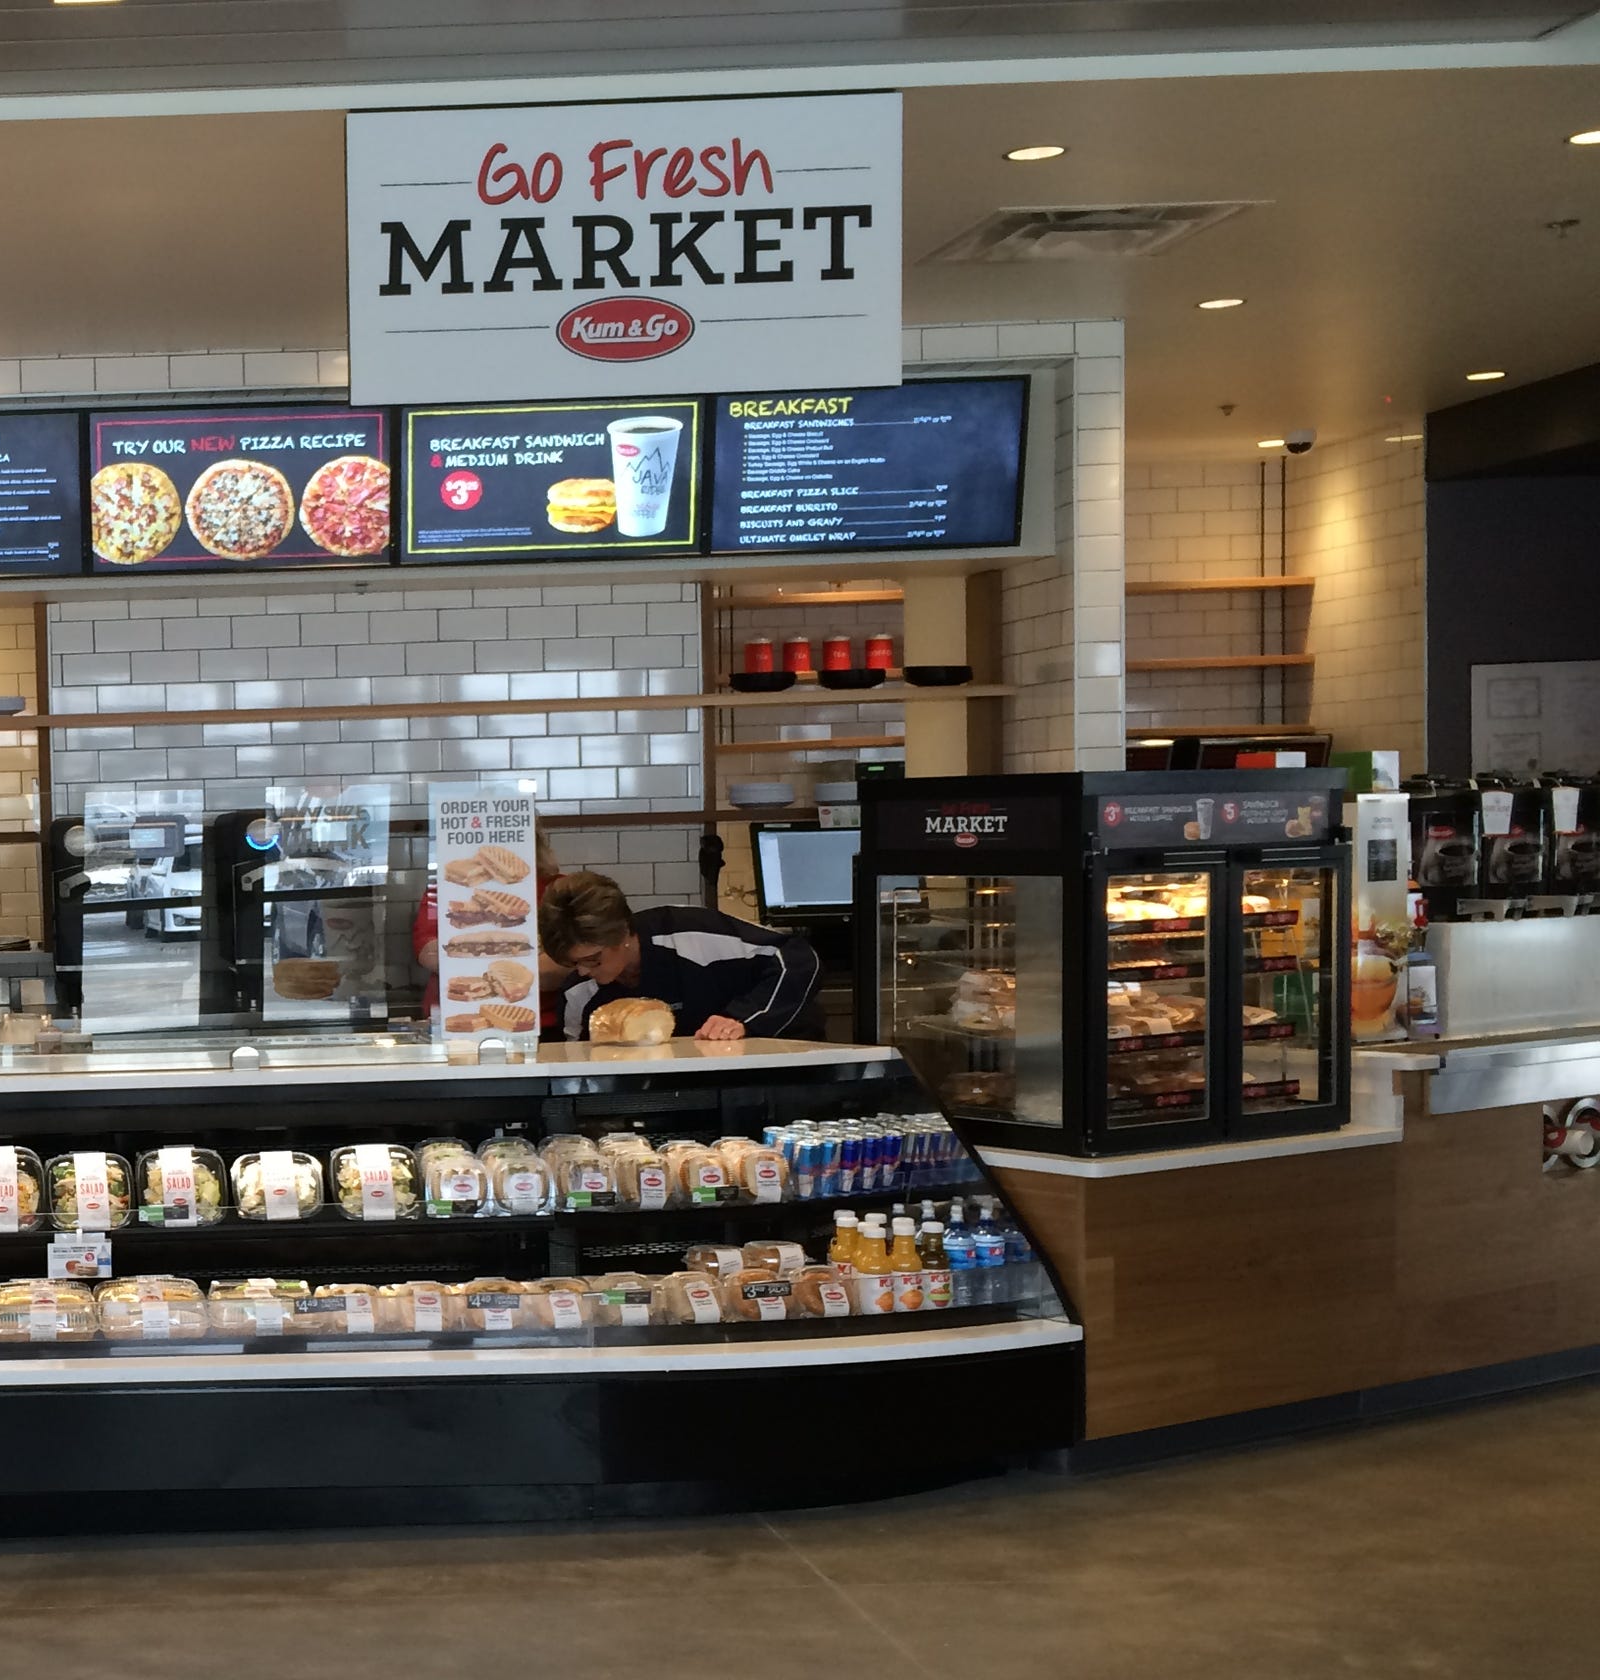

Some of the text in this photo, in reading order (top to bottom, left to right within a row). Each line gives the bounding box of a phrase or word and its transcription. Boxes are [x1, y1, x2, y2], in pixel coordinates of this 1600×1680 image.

[478, 138, 774, 205] Go Fresh
[379, 205, 872, 296] MARKET
[570, 316, 625, 343] Kum
[645, 314, 679, 341] Go
[730, 397, 853, 417] BREAKFAST
[744, 419, 854, 430] BREAKFAST SANDWICHES
[113, 434, 366, 455] TRY OUR NEW PIZZA RECIPE
[430, 434, 604, 451] BREAKFAST SANDWICH
[431, 451, 563, 467] & MEDIUM DRINK
[633, 470, 667, 485] JAVA
[741, 487, 859, 498] BREAKFAST PIZZA SLICE
[741, 503, 838, 513] BREAKFAST BURRITO
[740, 517, 843, 528] BISCUITS AND GRAVY
[740, 532, 856, 543] ULTIMATE OMELET WRAP
[441, 800, 529, 814] ORDER YOUR
[441, 815, 530, 829] HOT & FRESH
[925, 816, 1008, 833] MARKET
[448, 830, 524, 844] FOOD HERE
[364, 1170, 389, 1182] SALAD
[80, 1183, 104, 1195] SALAD
[166, 1178, 191, 1189] SALAD
